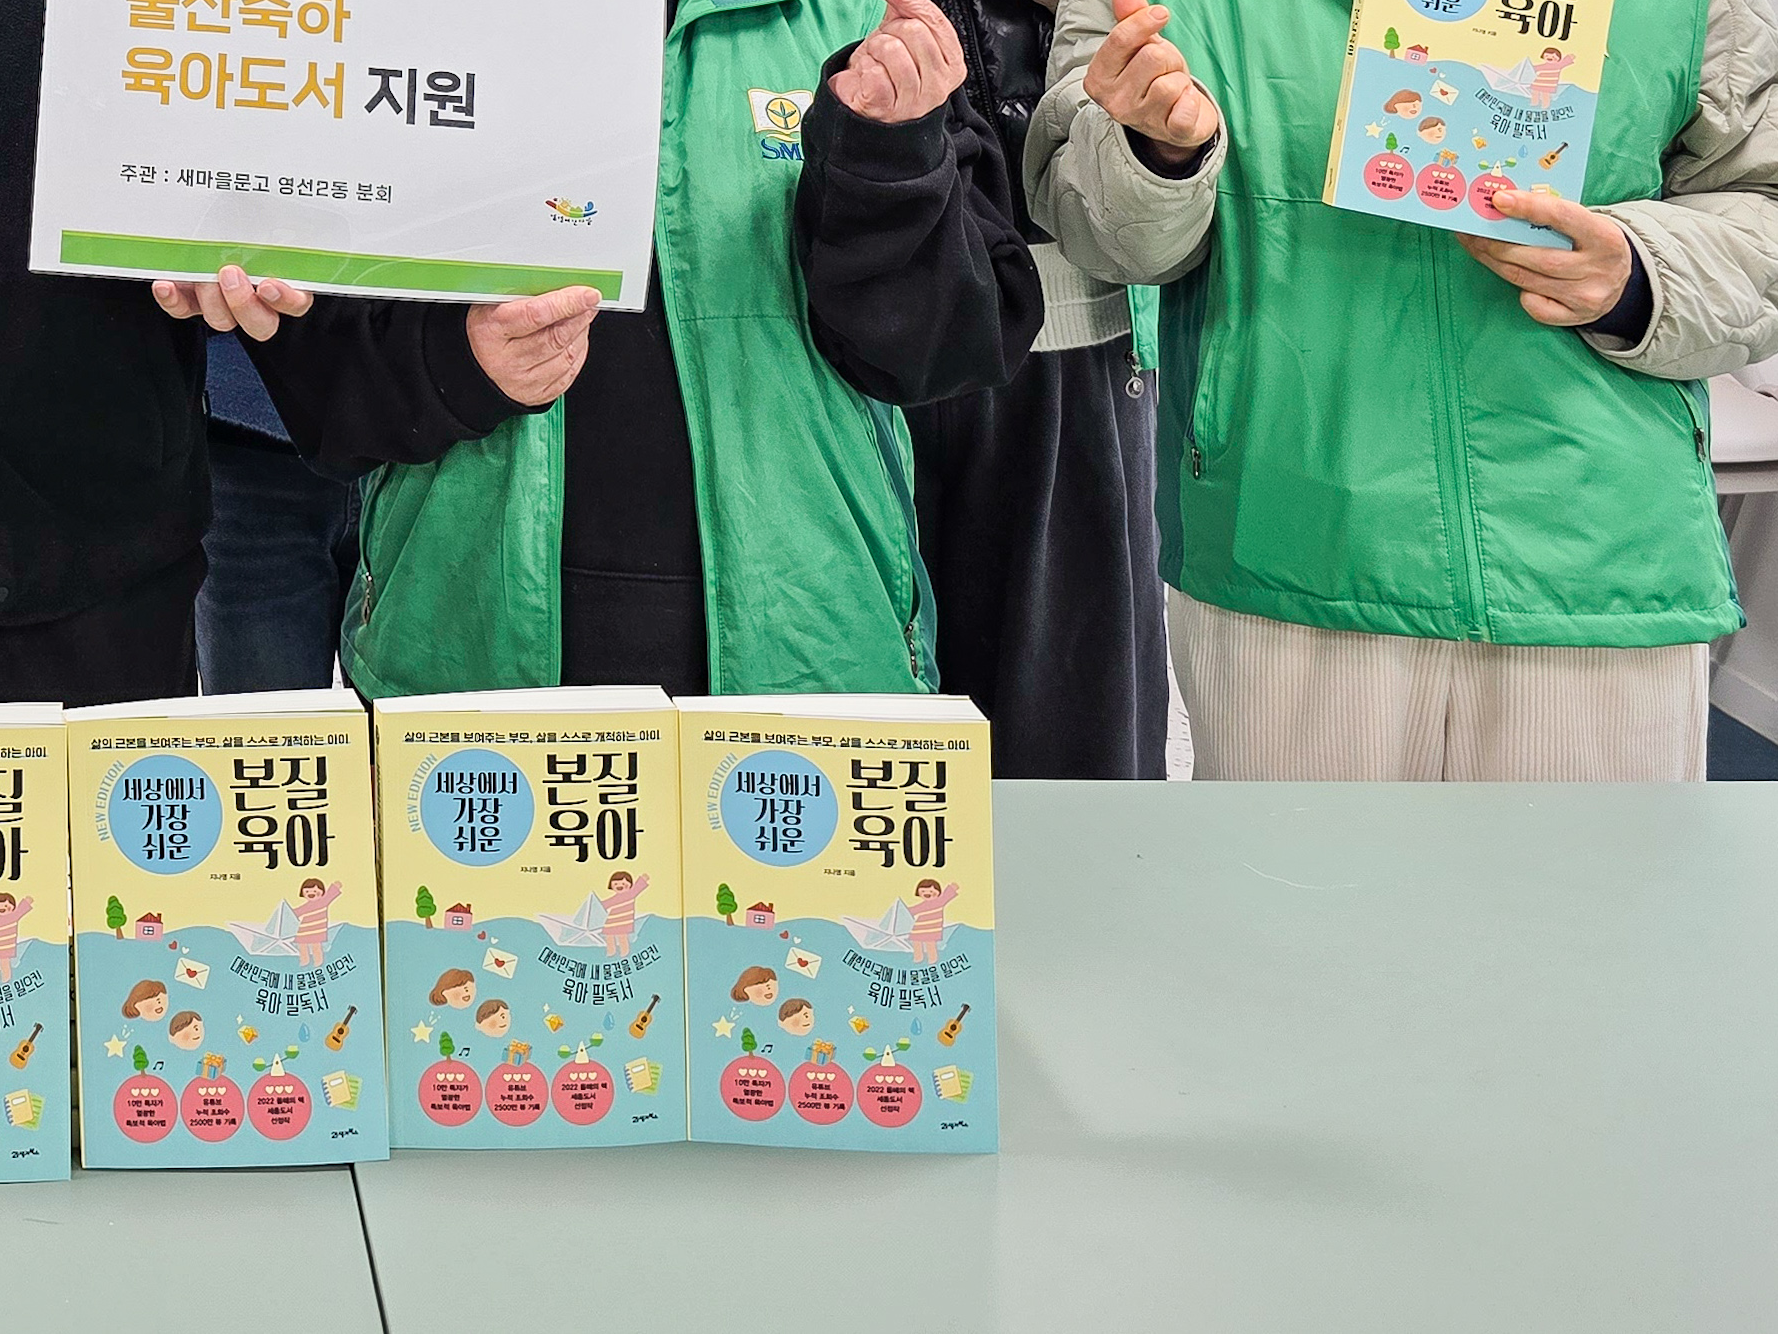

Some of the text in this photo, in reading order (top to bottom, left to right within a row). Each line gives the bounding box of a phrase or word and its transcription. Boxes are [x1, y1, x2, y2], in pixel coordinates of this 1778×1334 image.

[120, 46, 477, 129] 육아도서 지원
[761, 139, 805, 160] SM
[120, 164, 157, 184] 주관
[176, 168, 270, 193] 새마을문고
[278, 177, 349, 200] 영선2동
[356, 183, 392, 203] 분회
[123, 778, 205, 801] 세상에서
[230, 755, 328, 811] 본질
[435, 772, 517, 794] 세상에서
[542, 752, 639, 805] 본질
[736, 772, 820, 796] 세상에서
[846, 757, 947, 812] 본질
[141, 804, 190, 831] 가장
[453, 798, 503, 824] 가장
[754, 798, 805, 826] 가장
[142, 833, 191, 859] 쉬운
[234, 813, 334, 869] 육아
[453, 826, 502, 852] 쉬운
[545, 808, 644, 862] 육아
[755, 826, 805, 853] 쉬운
[849, 814, 952, 868] 육아
[563, 978, 633, 1005] 육아 필독서
[868, 982, 942, 1010] 육아 필독서
